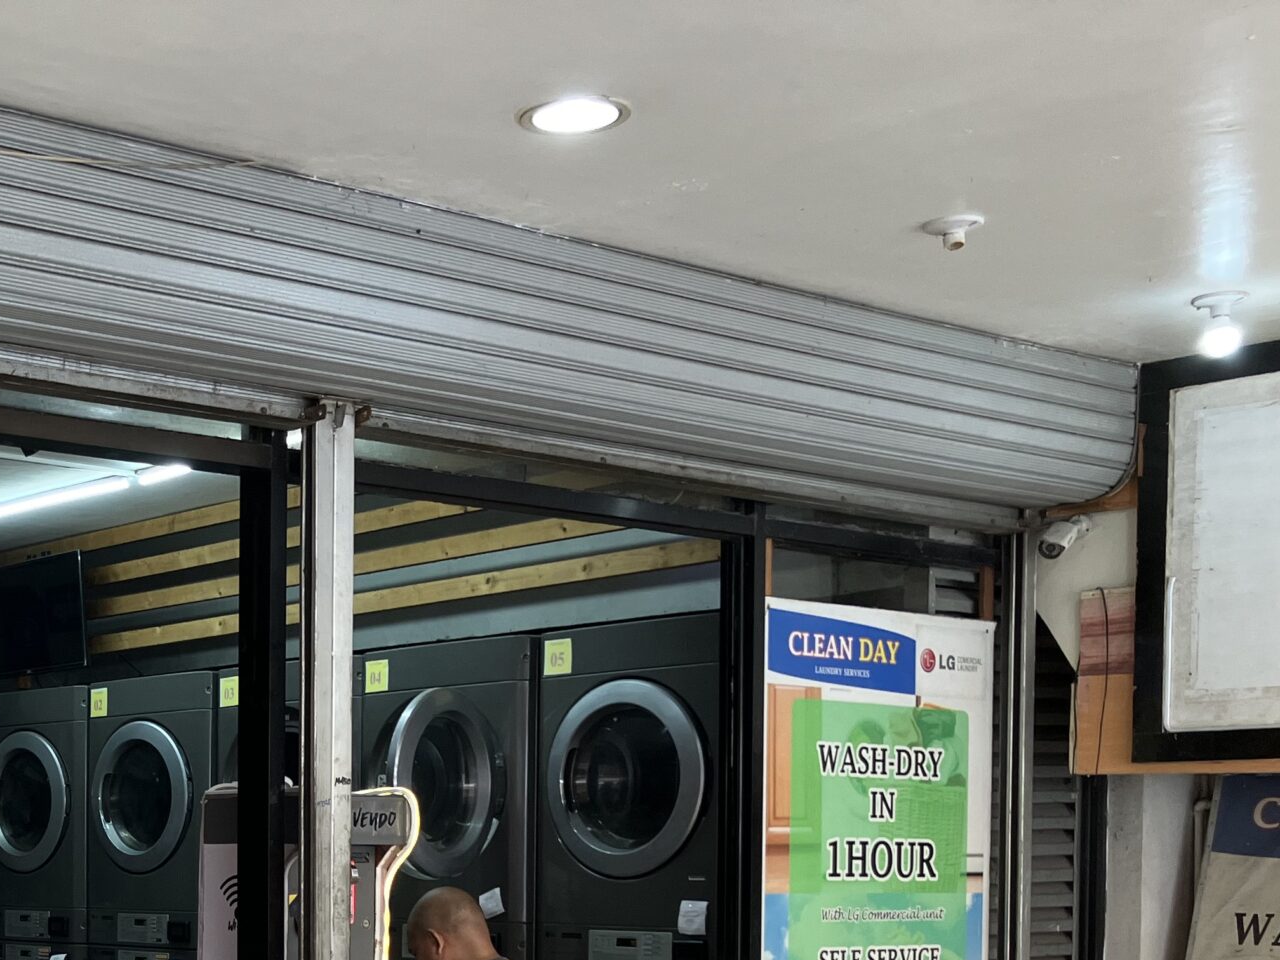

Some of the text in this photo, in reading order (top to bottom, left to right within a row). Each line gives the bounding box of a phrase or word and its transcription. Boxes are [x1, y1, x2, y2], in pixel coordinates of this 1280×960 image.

[550, 651, 565, 667] 05
[788, 630, 901, 665] CLEAN DAY
[815, 665, 870, 678] LAUNDRY SERVICES
[939, 652, 956, 671] LG
[818, 743, 944, 779] WASH-DRY
[870, 791, 896, 819] IN
[826, 839, 937, 879] 1HOUR
[820, 907, 846, 921] With
[861, 905, 920, 921] Commercial
[922, 906, 945, 921] unit
